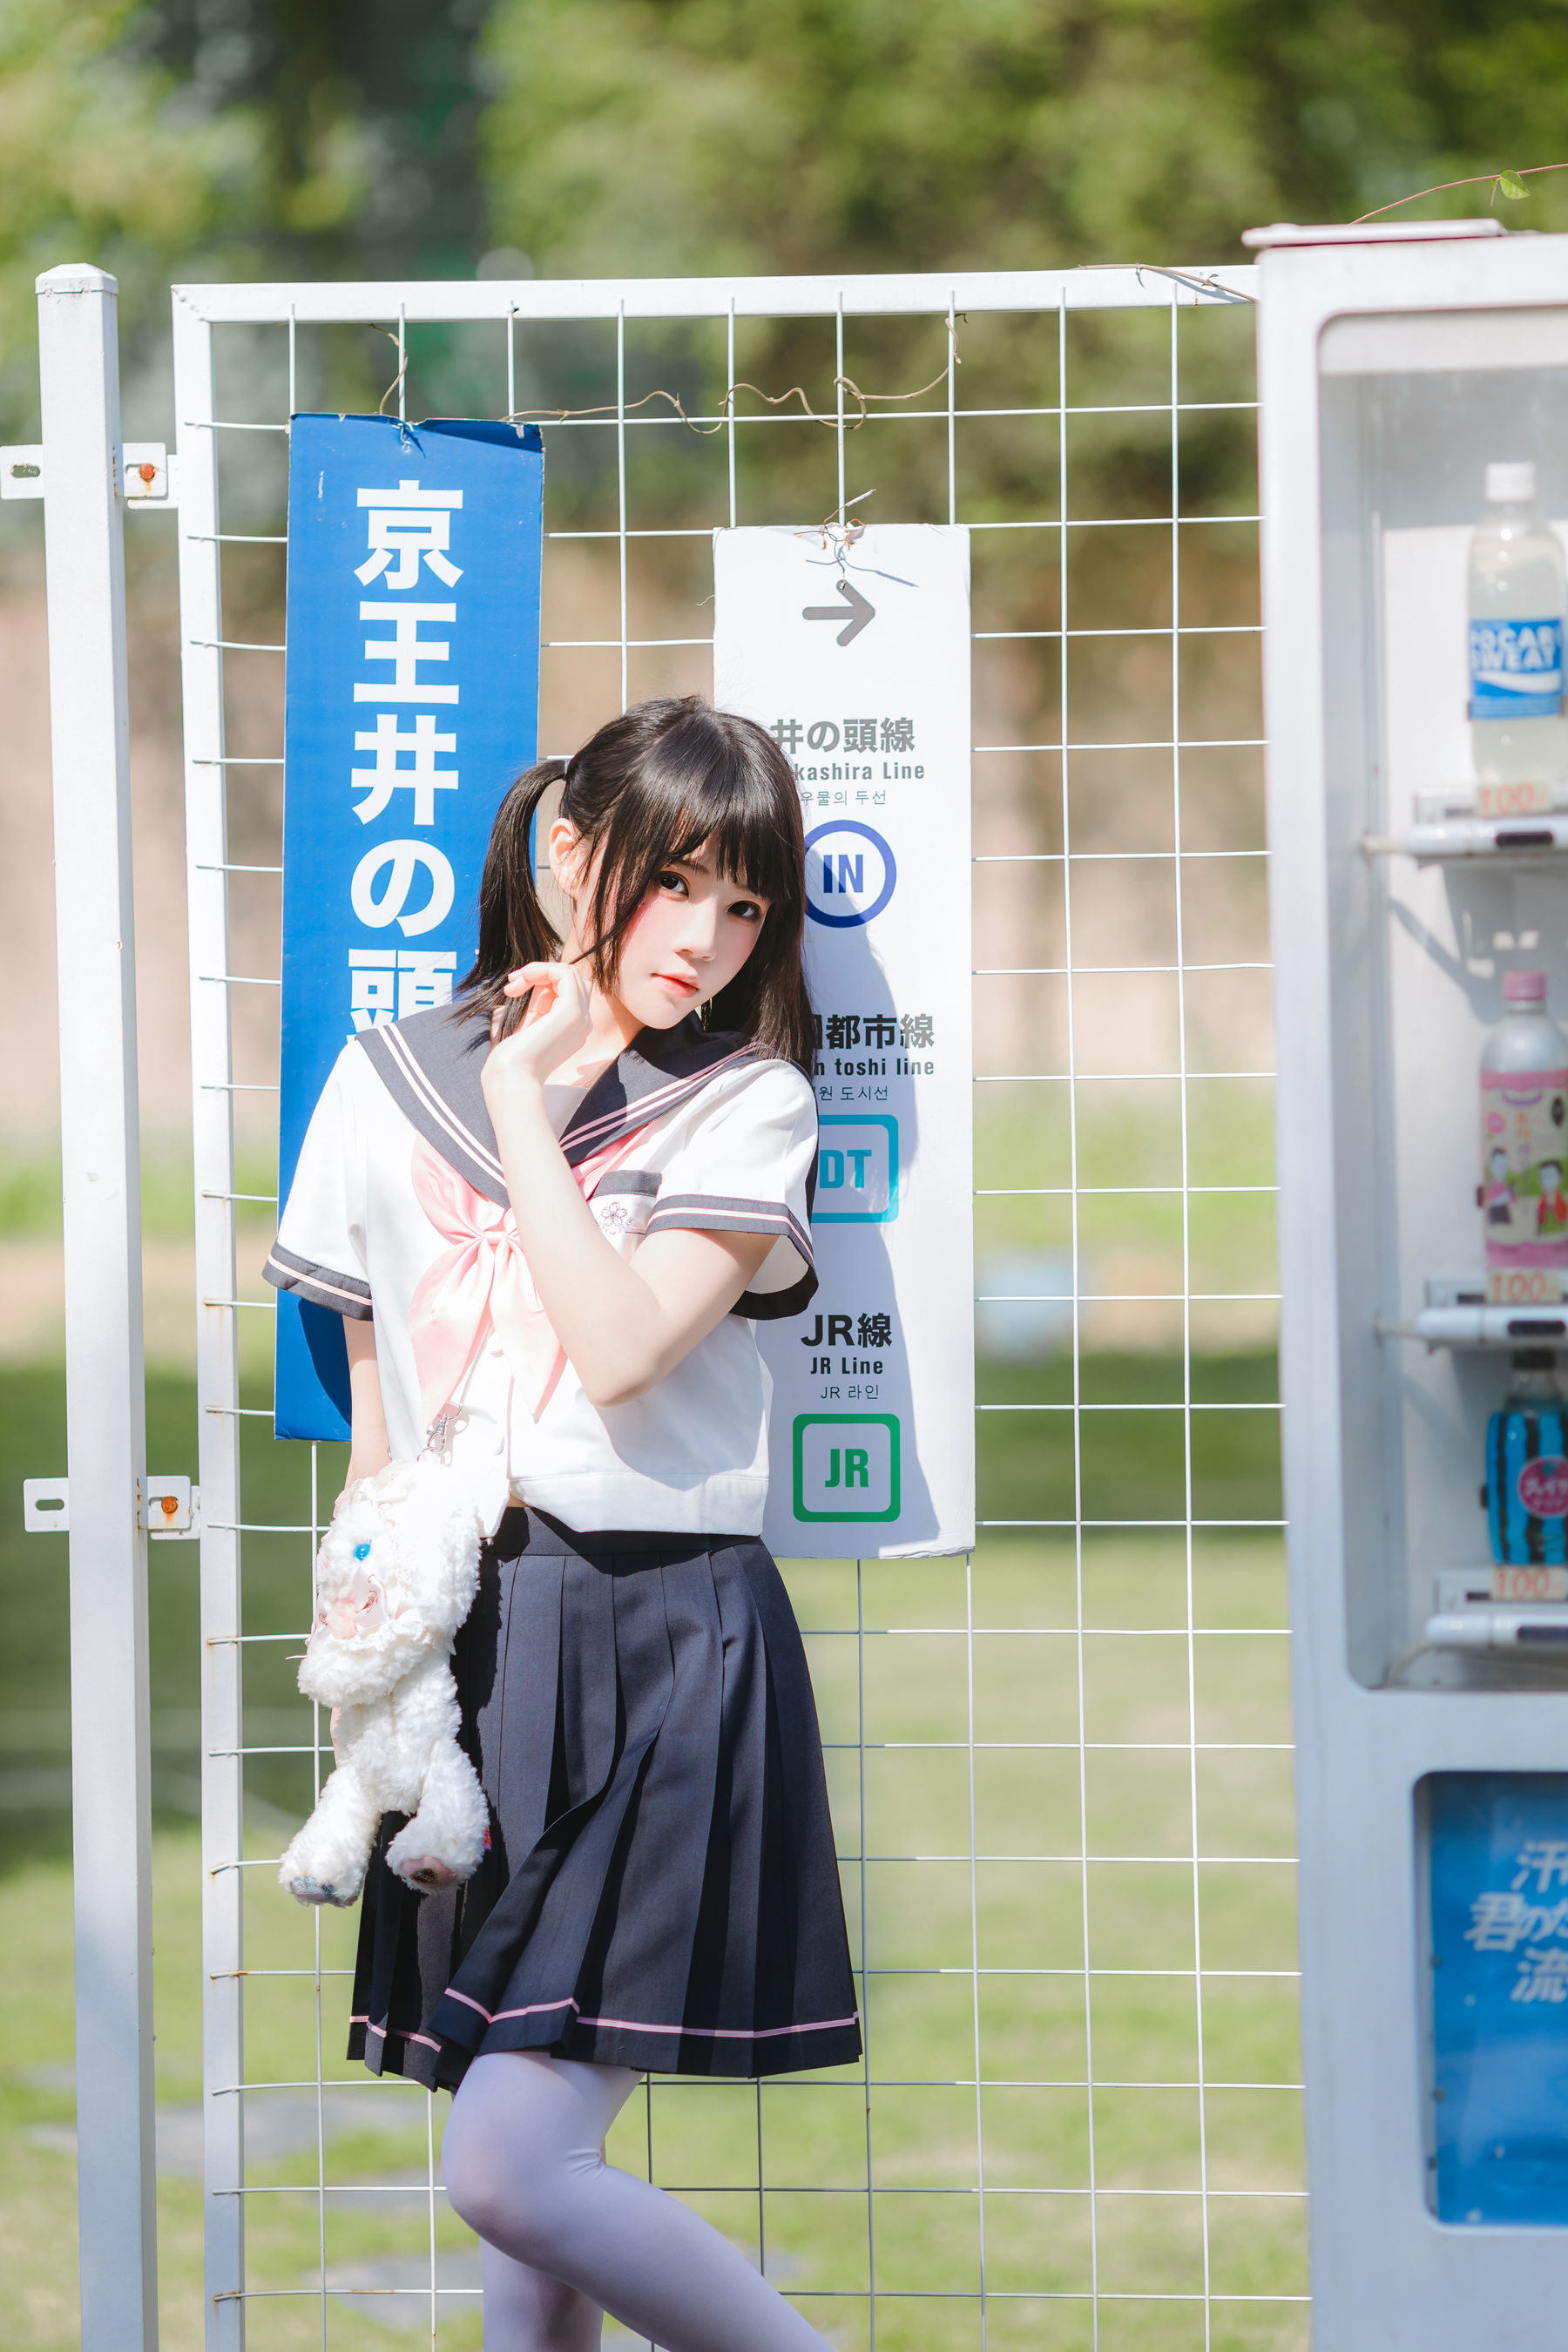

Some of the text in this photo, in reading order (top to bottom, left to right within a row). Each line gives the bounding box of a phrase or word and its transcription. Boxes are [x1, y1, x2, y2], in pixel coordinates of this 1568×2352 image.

[770, 717, 916, 754] 井の頭線
[347, 479, 464, 1042] 京王井の頭
[882, 761, 925, 780] Line
[801, 789, 888, 807] 우물의 두선
[822, 854, 864, 894] IN
[814, 1013, 935, 1050] 都市線
[835, 1058, 886, 1076] toshi
[896, 1057, 935, 1076] line
[814, 1085, 889, 1101] 원 도시선
[819, 1149, 872, 1189] DT
[800, 1312, 893, 1348] JR線
[810, 1356, 884, 1375] JR Line
[820, 1384, 880, 1400] JR 라인
[824, 1448, 870, 1489] JR
